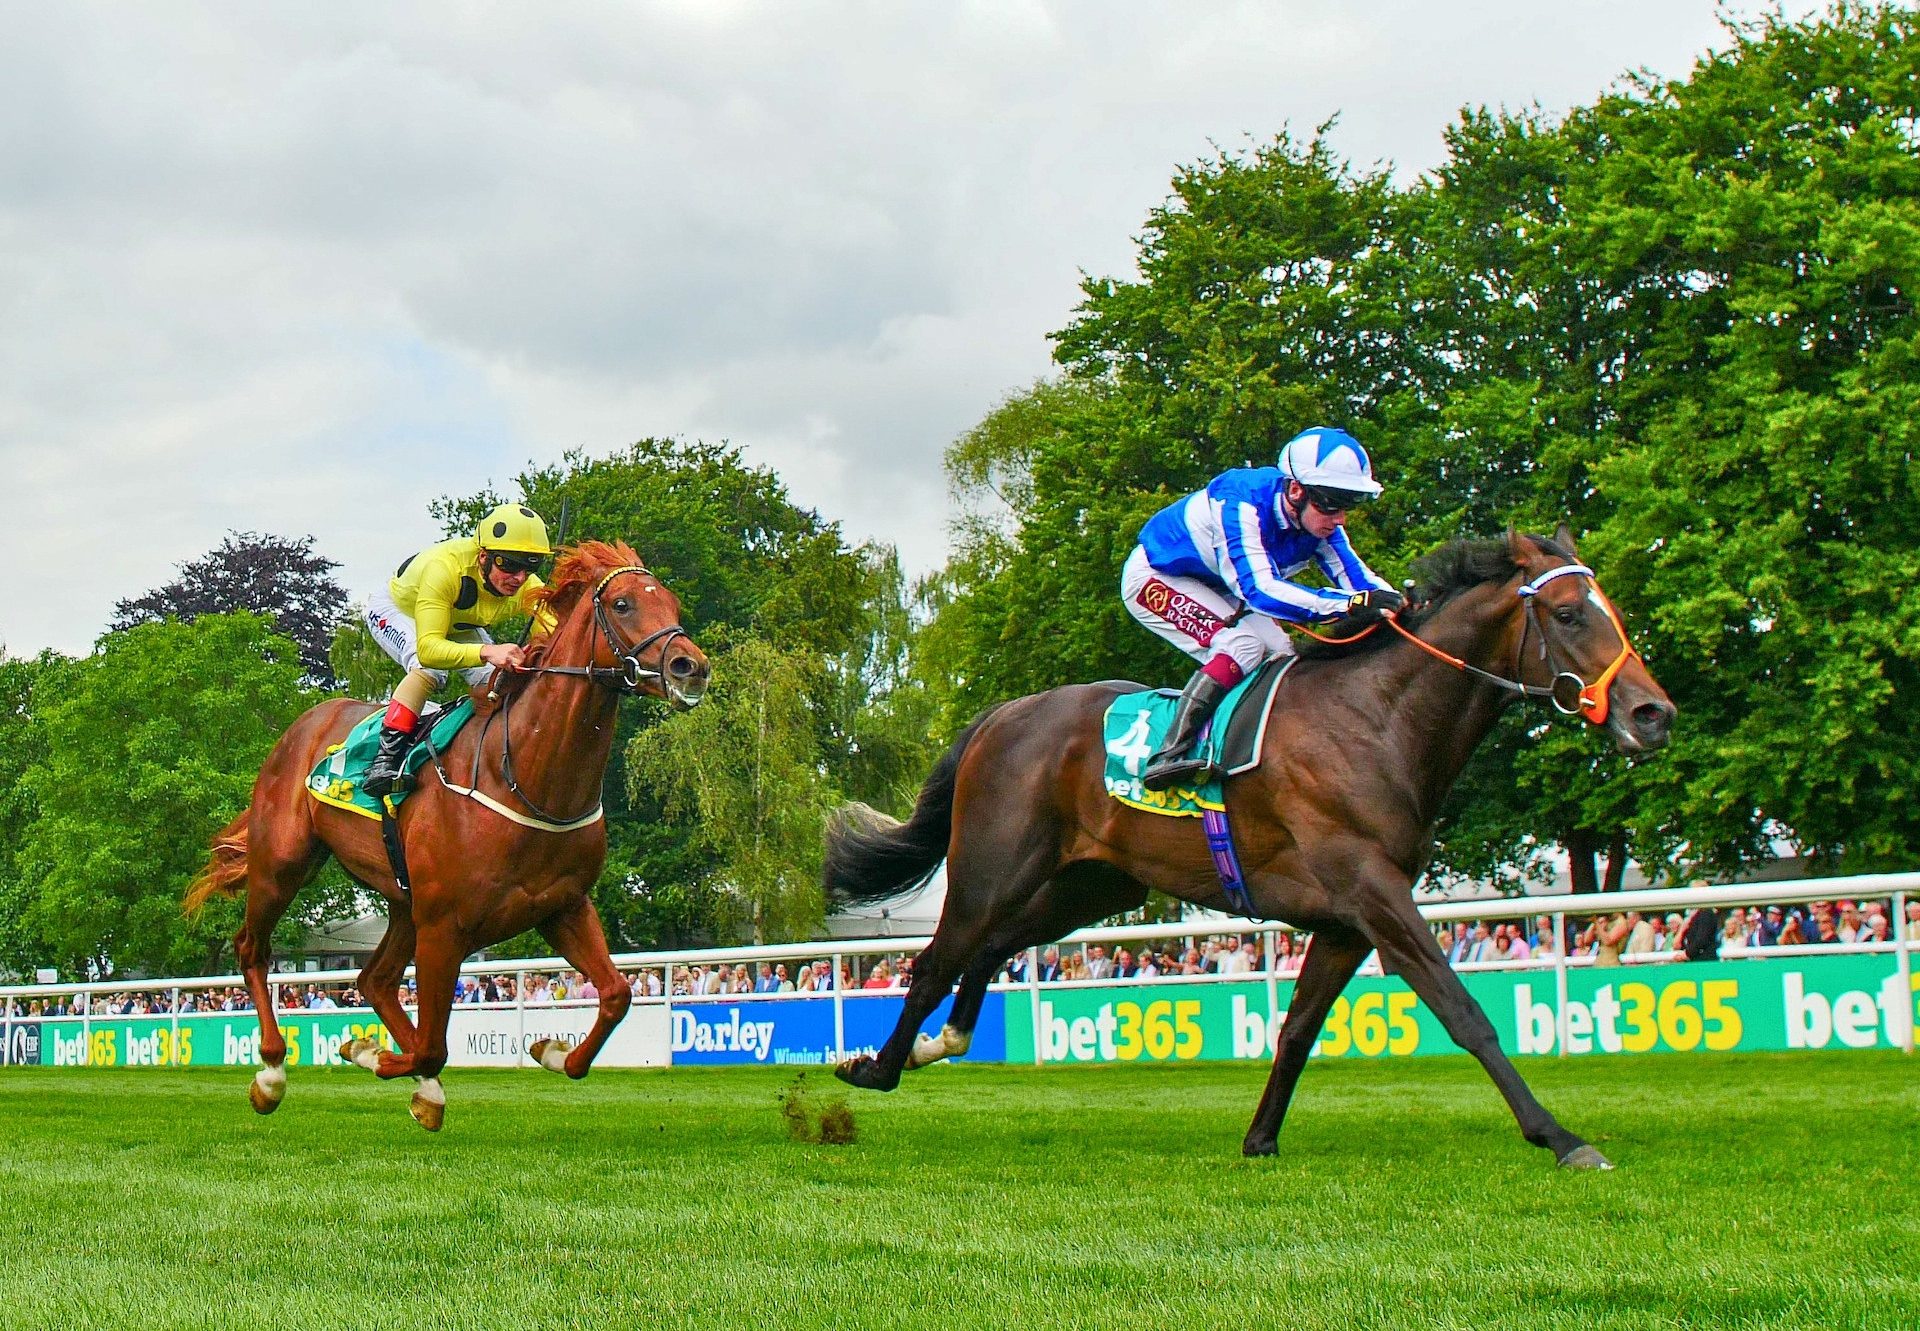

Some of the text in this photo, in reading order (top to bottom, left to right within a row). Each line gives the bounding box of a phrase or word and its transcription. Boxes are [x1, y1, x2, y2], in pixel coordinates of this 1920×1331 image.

[1106, 709, 1151, 776] 4
[671, 1008, 775, 1061] Darley
[1039, 1000, 1204, 1061] bet365
[1232, 992, 1420, 1059] b365
[1514, 979, 1744, 1055] bet365
[1782, 971, 1920, 1048] bet
[223, 1024, 300, 1066] bet5
[467, 1030, 507, 1055] MOËT
[510, 1037, 518, 1055] &
[774, 1047, 823, 1064] Winning
[824, 1045, 836, 1064] is
